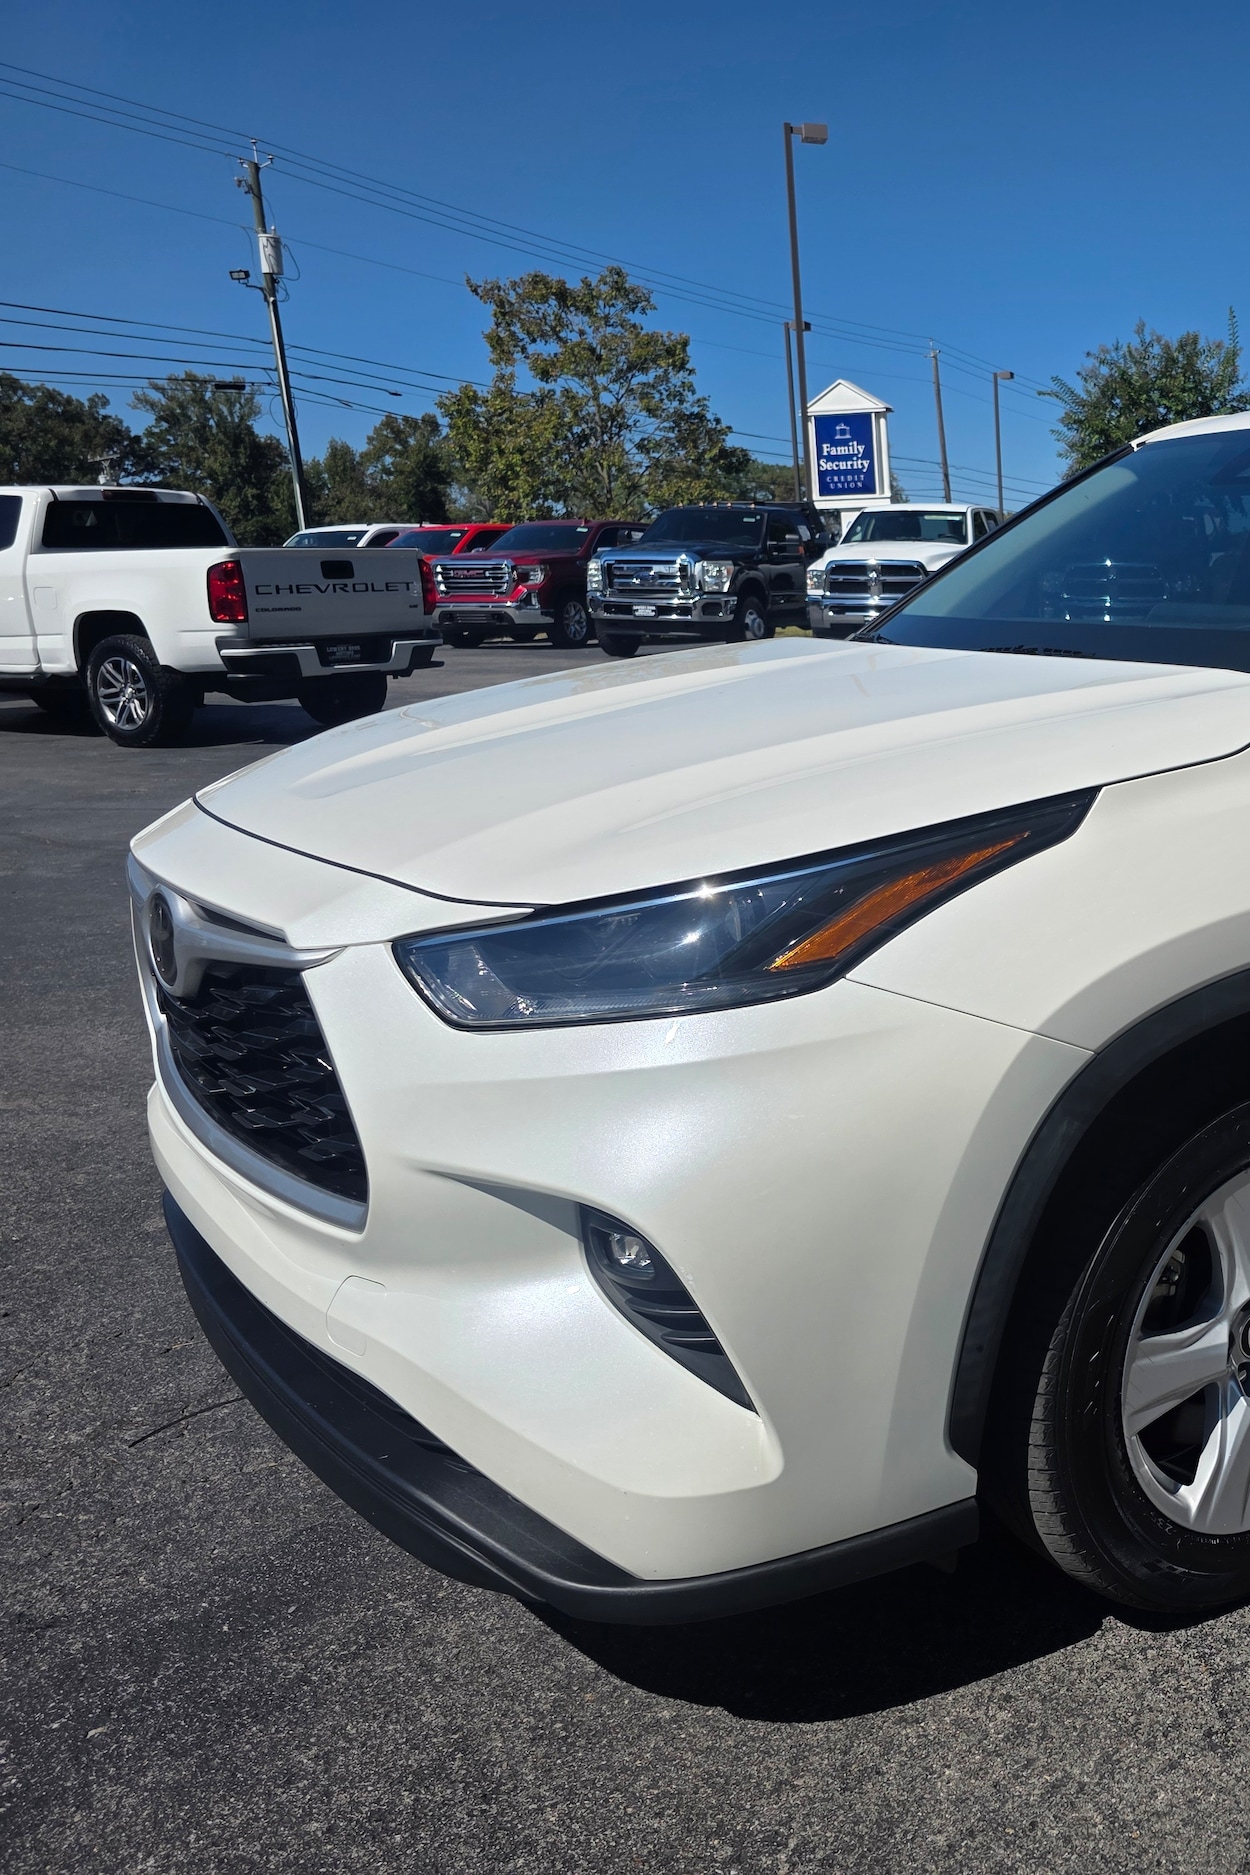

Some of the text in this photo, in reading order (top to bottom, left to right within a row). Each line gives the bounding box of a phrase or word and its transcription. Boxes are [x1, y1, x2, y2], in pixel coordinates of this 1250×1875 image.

[822, 441, 865, 457] Family
[819, 457, 870, 472] Security
[255, 581, 414, 595] CHEVROLET
